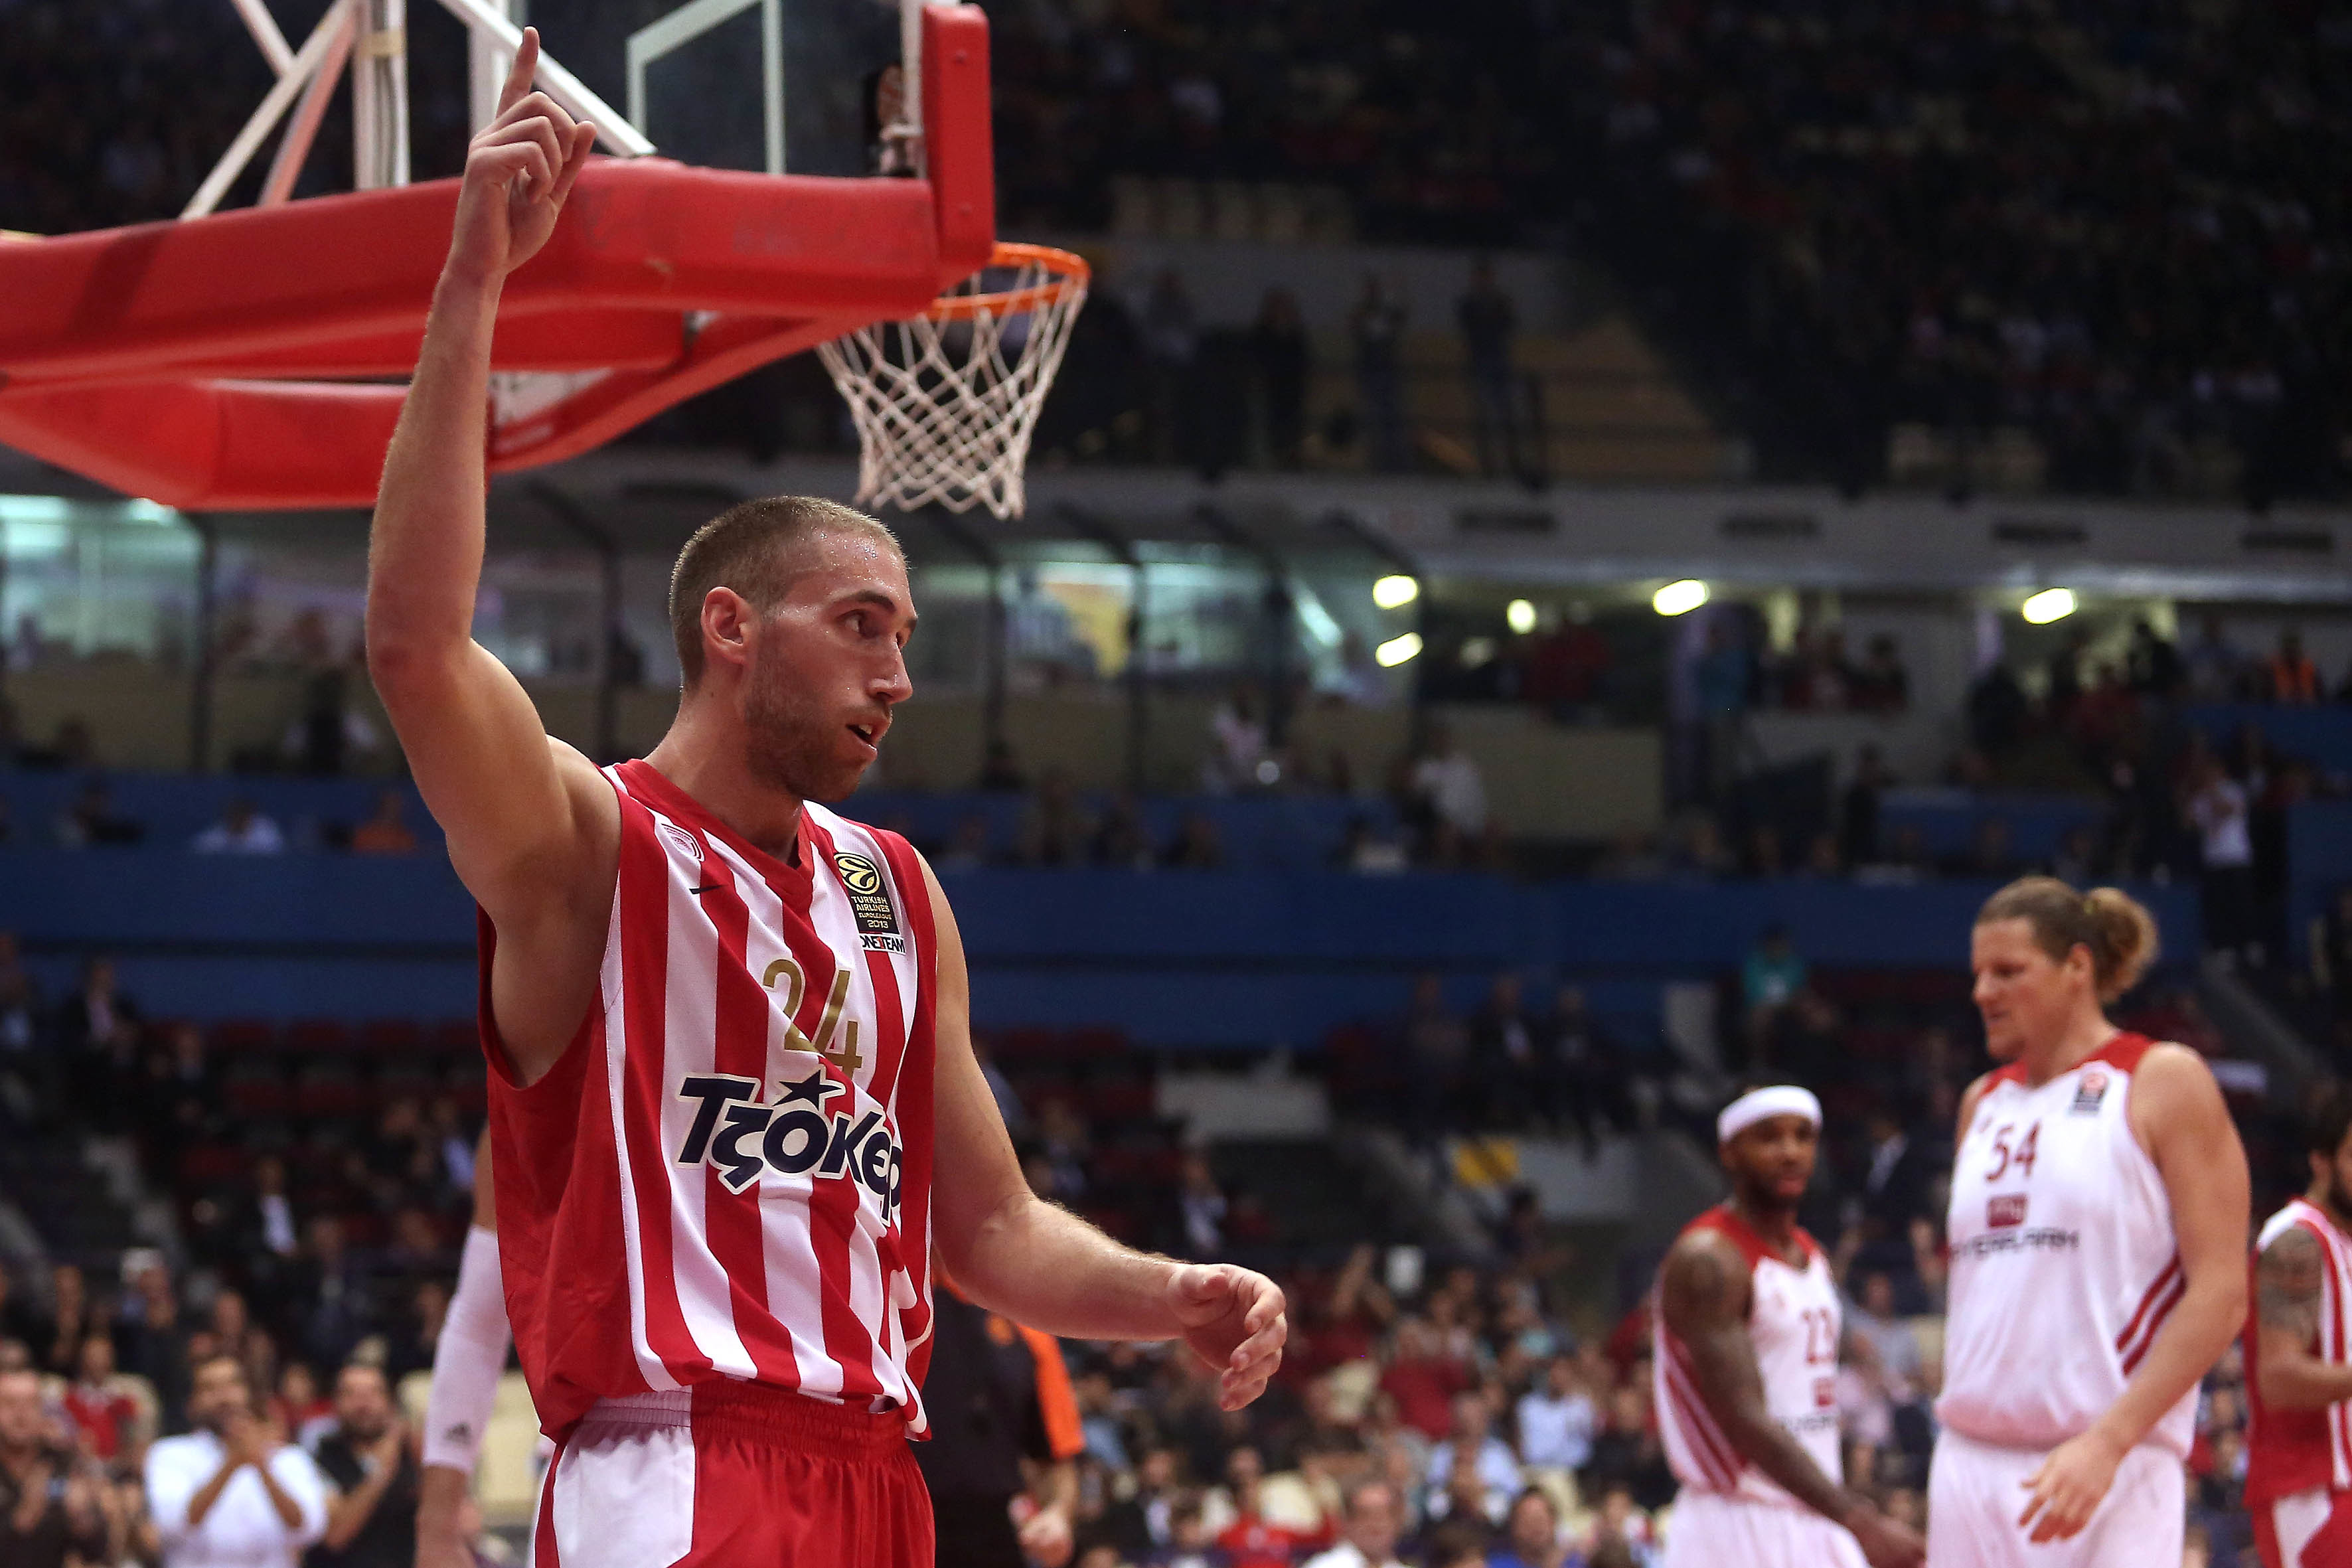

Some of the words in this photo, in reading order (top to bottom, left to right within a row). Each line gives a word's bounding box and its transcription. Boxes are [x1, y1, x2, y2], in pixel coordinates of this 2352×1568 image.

[851, 896, 888, 905] TURKISH
[856, 903, 890, 913] AIRLINES
[867, 919, 889, 929] 2013
[763, 959, 862, 1080] 24
[1984, 1119, 2040, 1182] 54
